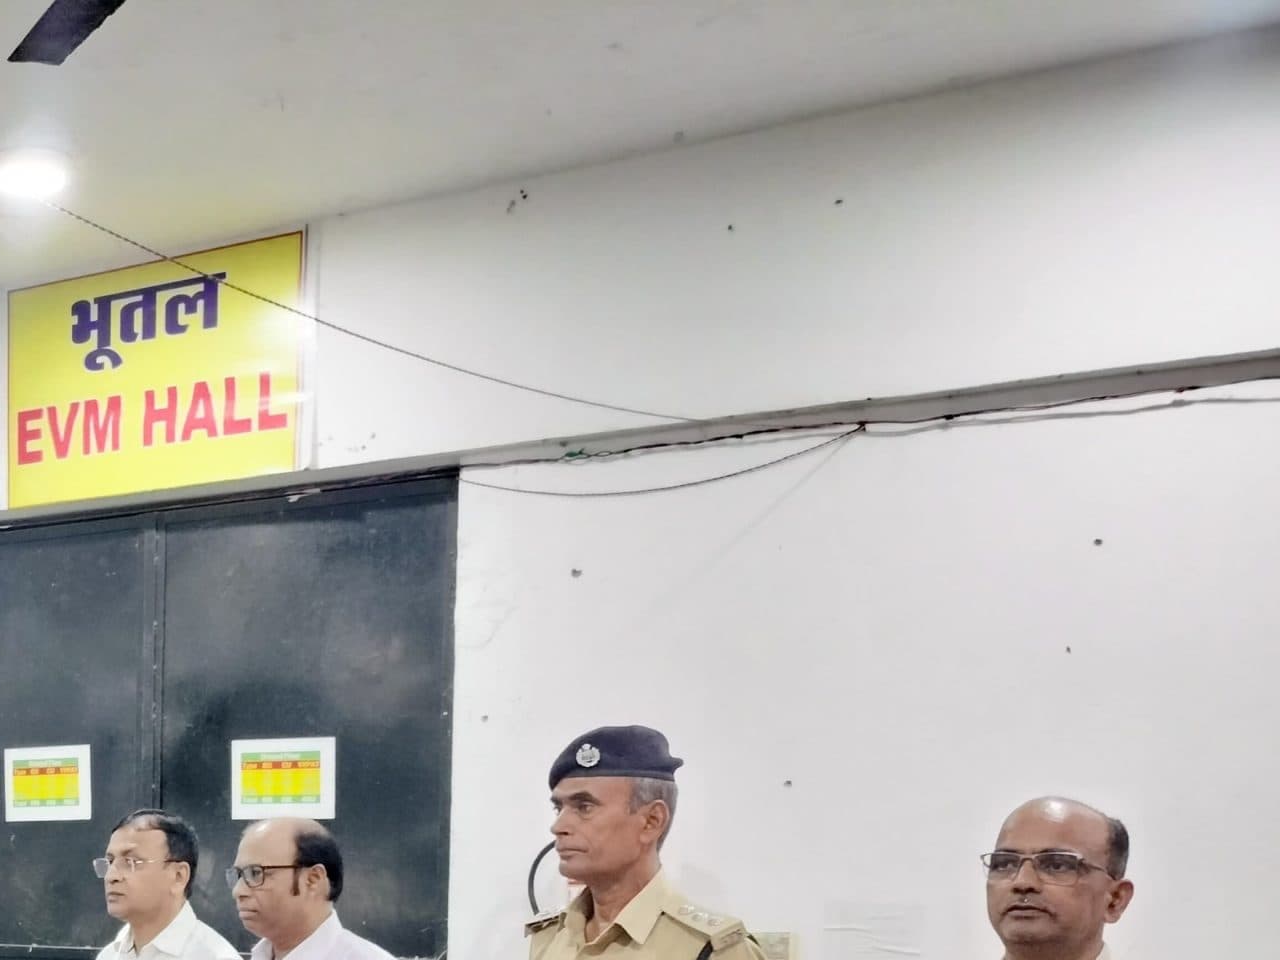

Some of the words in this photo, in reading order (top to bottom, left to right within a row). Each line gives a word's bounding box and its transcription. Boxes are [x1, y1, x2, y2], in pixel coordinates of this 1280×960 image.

[71, 271, 227, 371] भूतल
[17, 395, 121, 466] EVM
[143, 372, 288, 447] HALL
